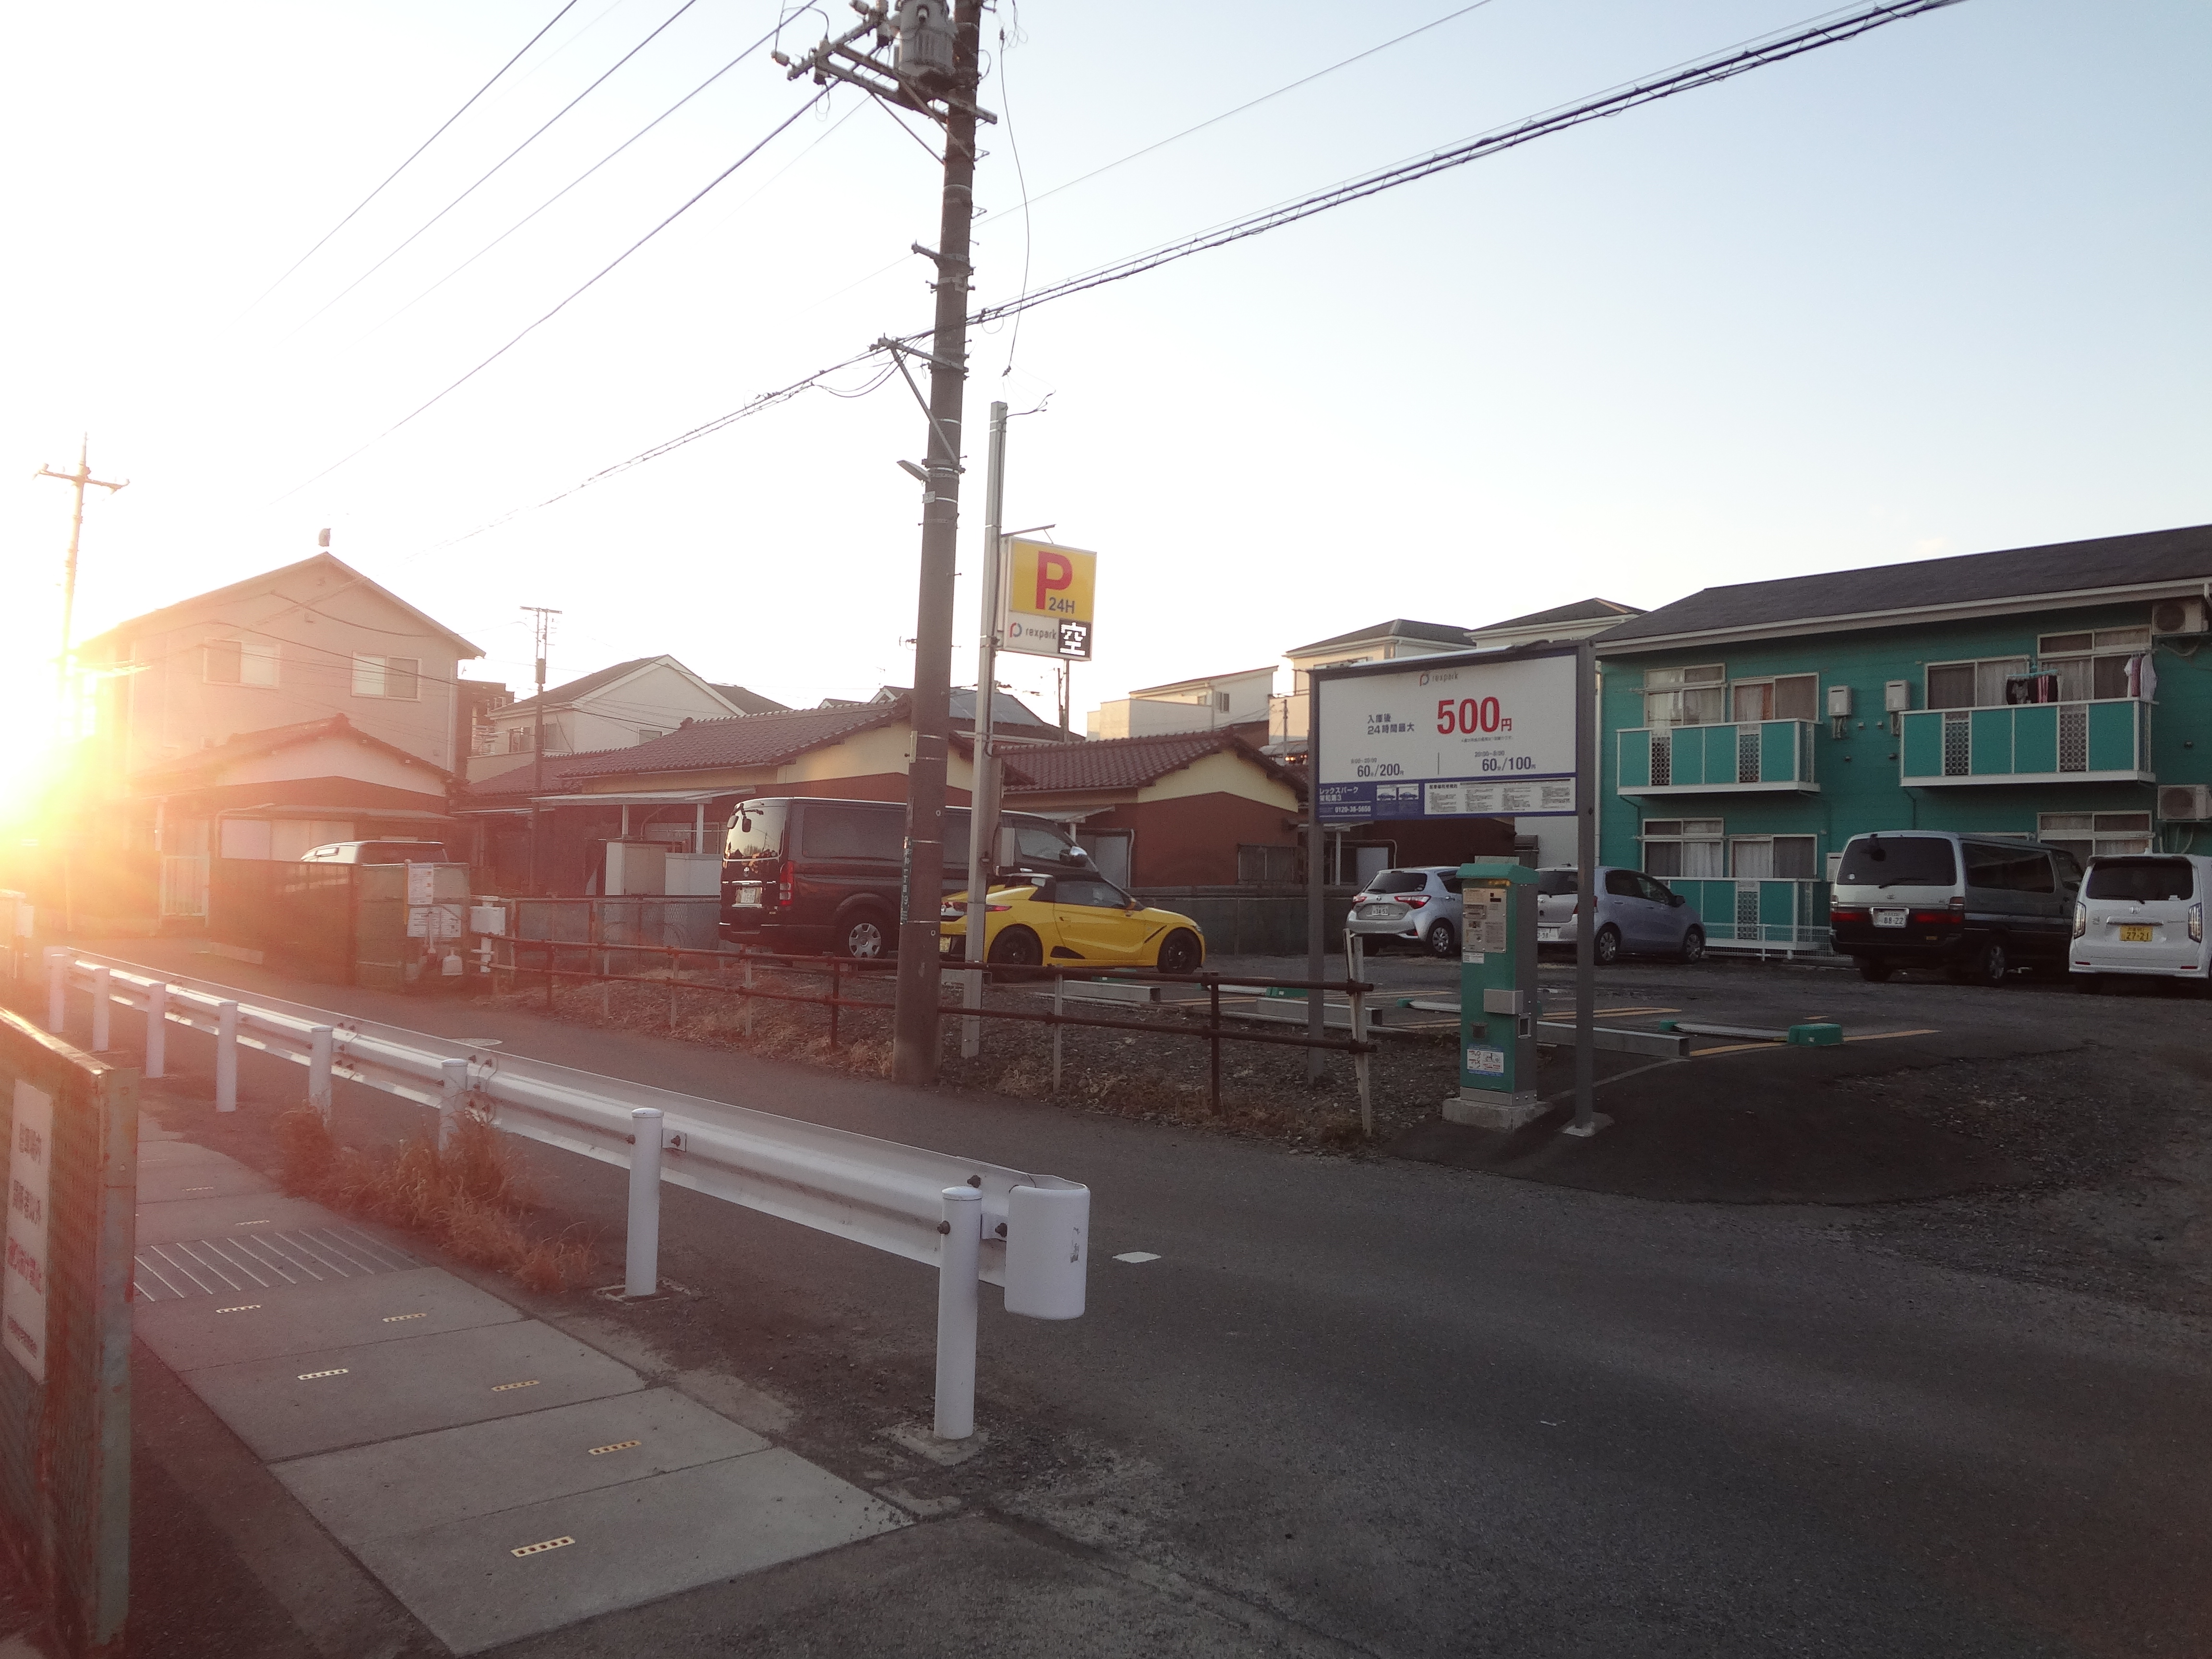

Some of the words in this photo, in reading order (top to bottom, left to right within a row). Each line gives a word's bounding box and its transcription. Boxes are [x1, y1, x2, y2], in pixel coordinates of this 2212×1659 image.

[1035, 550, 1073, 610] P
[1048, 597, 1076, 614] 24H
[1025, 628, 1057, 640] rexpark
[1059, 622, 1087, 656] 空
[1367, 722, 1415, 735] 24時間最大
[1319, 786, 1358, 795] レックスパーク
